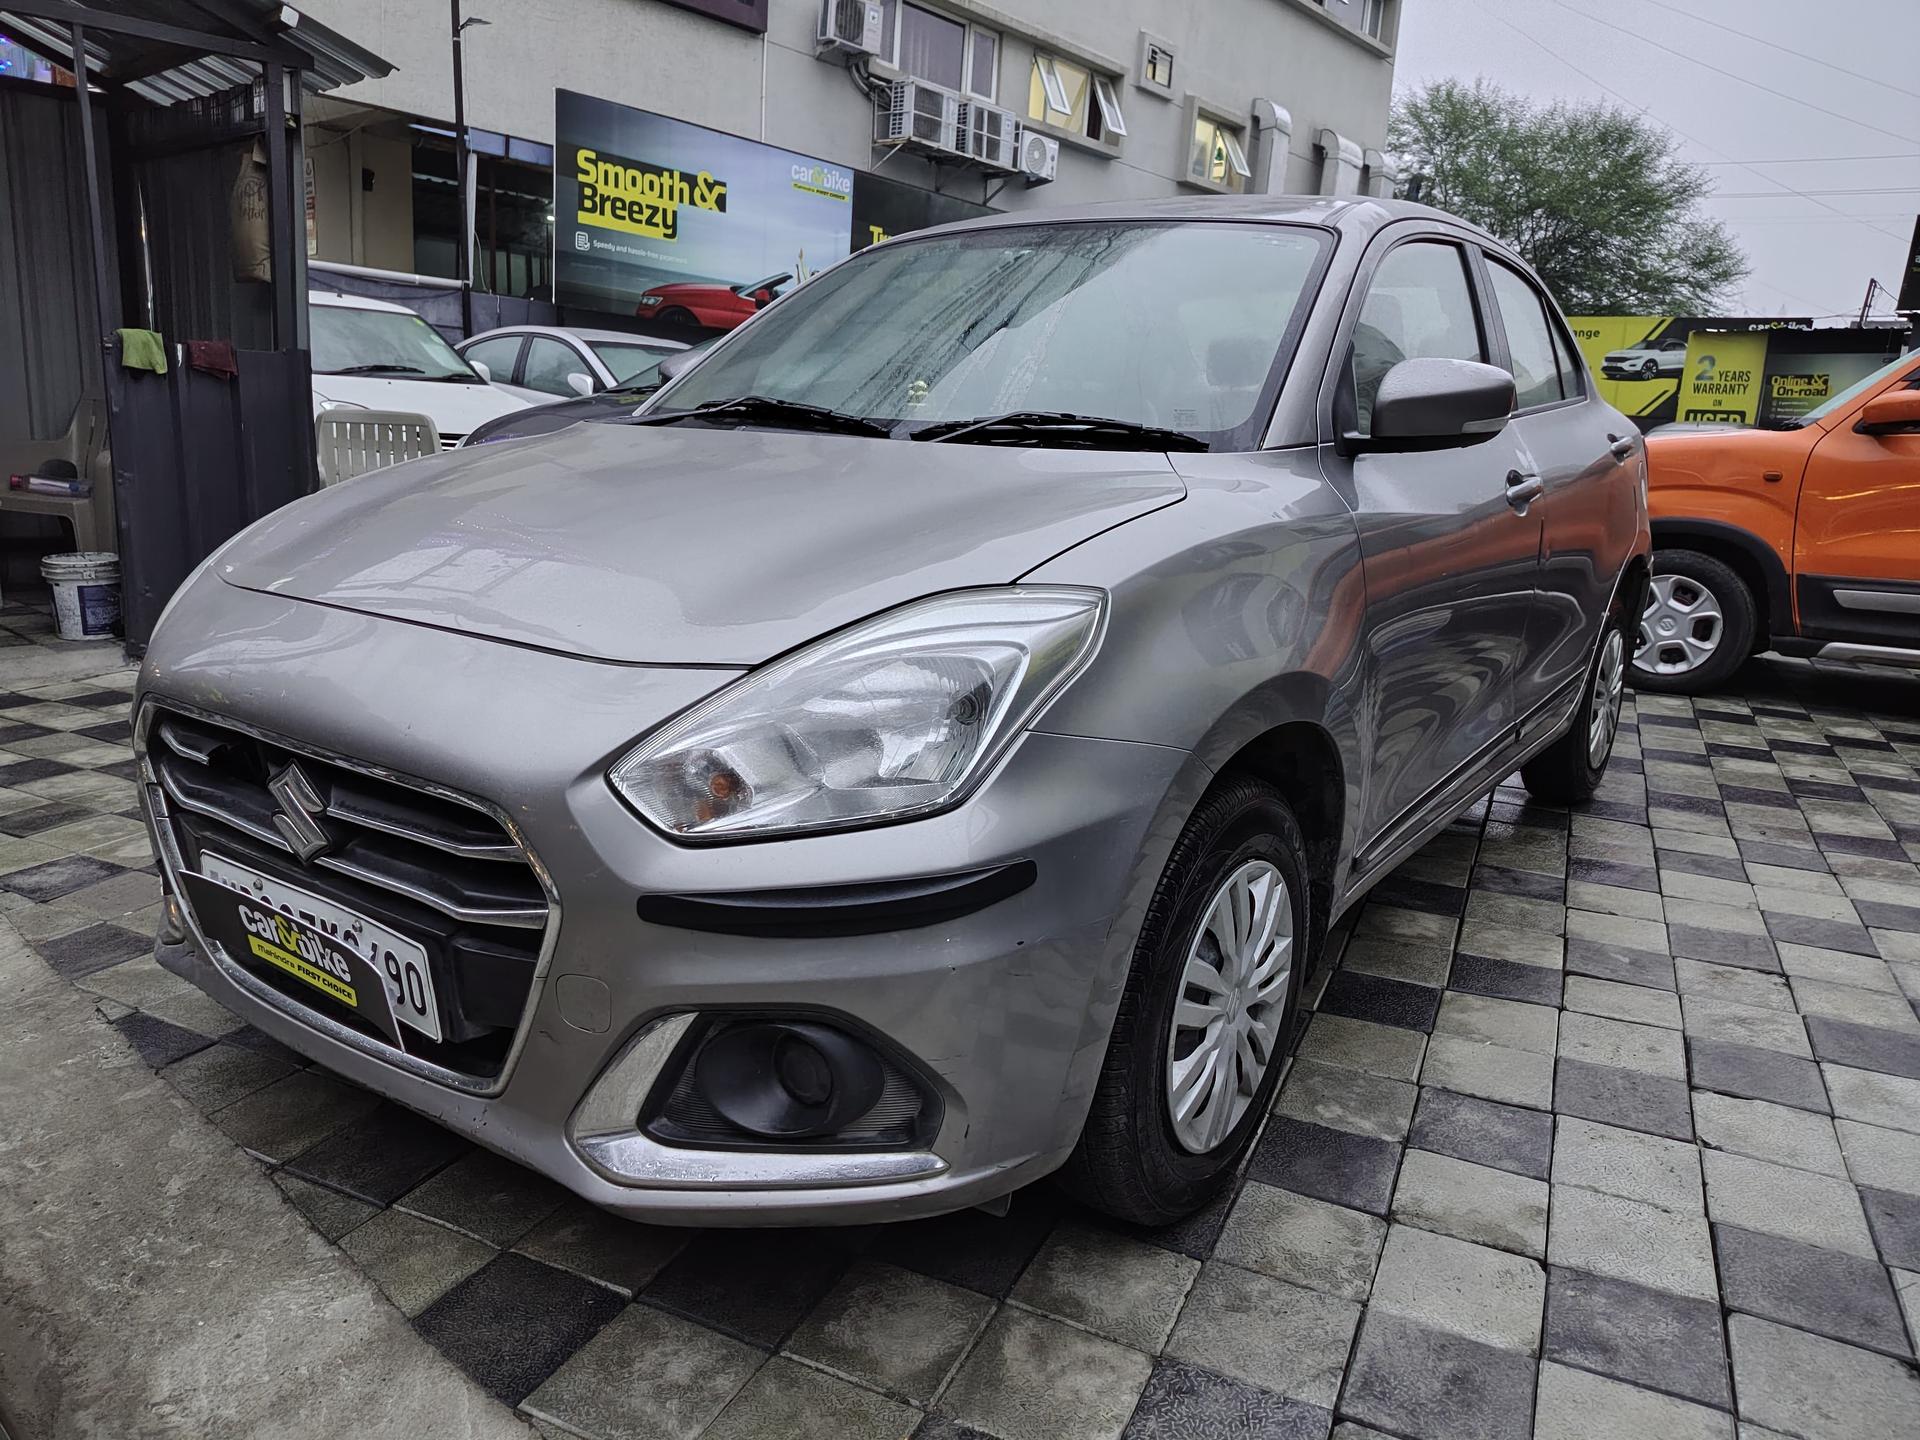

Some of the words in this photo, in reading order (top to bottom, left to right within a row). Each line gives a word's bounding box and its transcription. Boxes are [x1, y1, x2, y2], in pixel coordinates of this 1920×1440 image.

[577, 149, 689, 205] Smooth
[694, 170, 727, 211] &
[578, 182, 677, 239] Breezy
[593, 240, 615, 251] Speedy
[616, 245, 627, 253] and
[1695, 355, 1716, 381] 2
[1718, 370, 1751, 382] YEARS
[1771, 375, 1809, 387] Online
[1693, 382, 1749, 395] WARRANTY
[1777, 386, 1828, 397] On-road
[1713, 399, 1722, 407] ON
[297, 964, 321, 982] FIRST
[322, 978, 354, 1000] CHOICE
